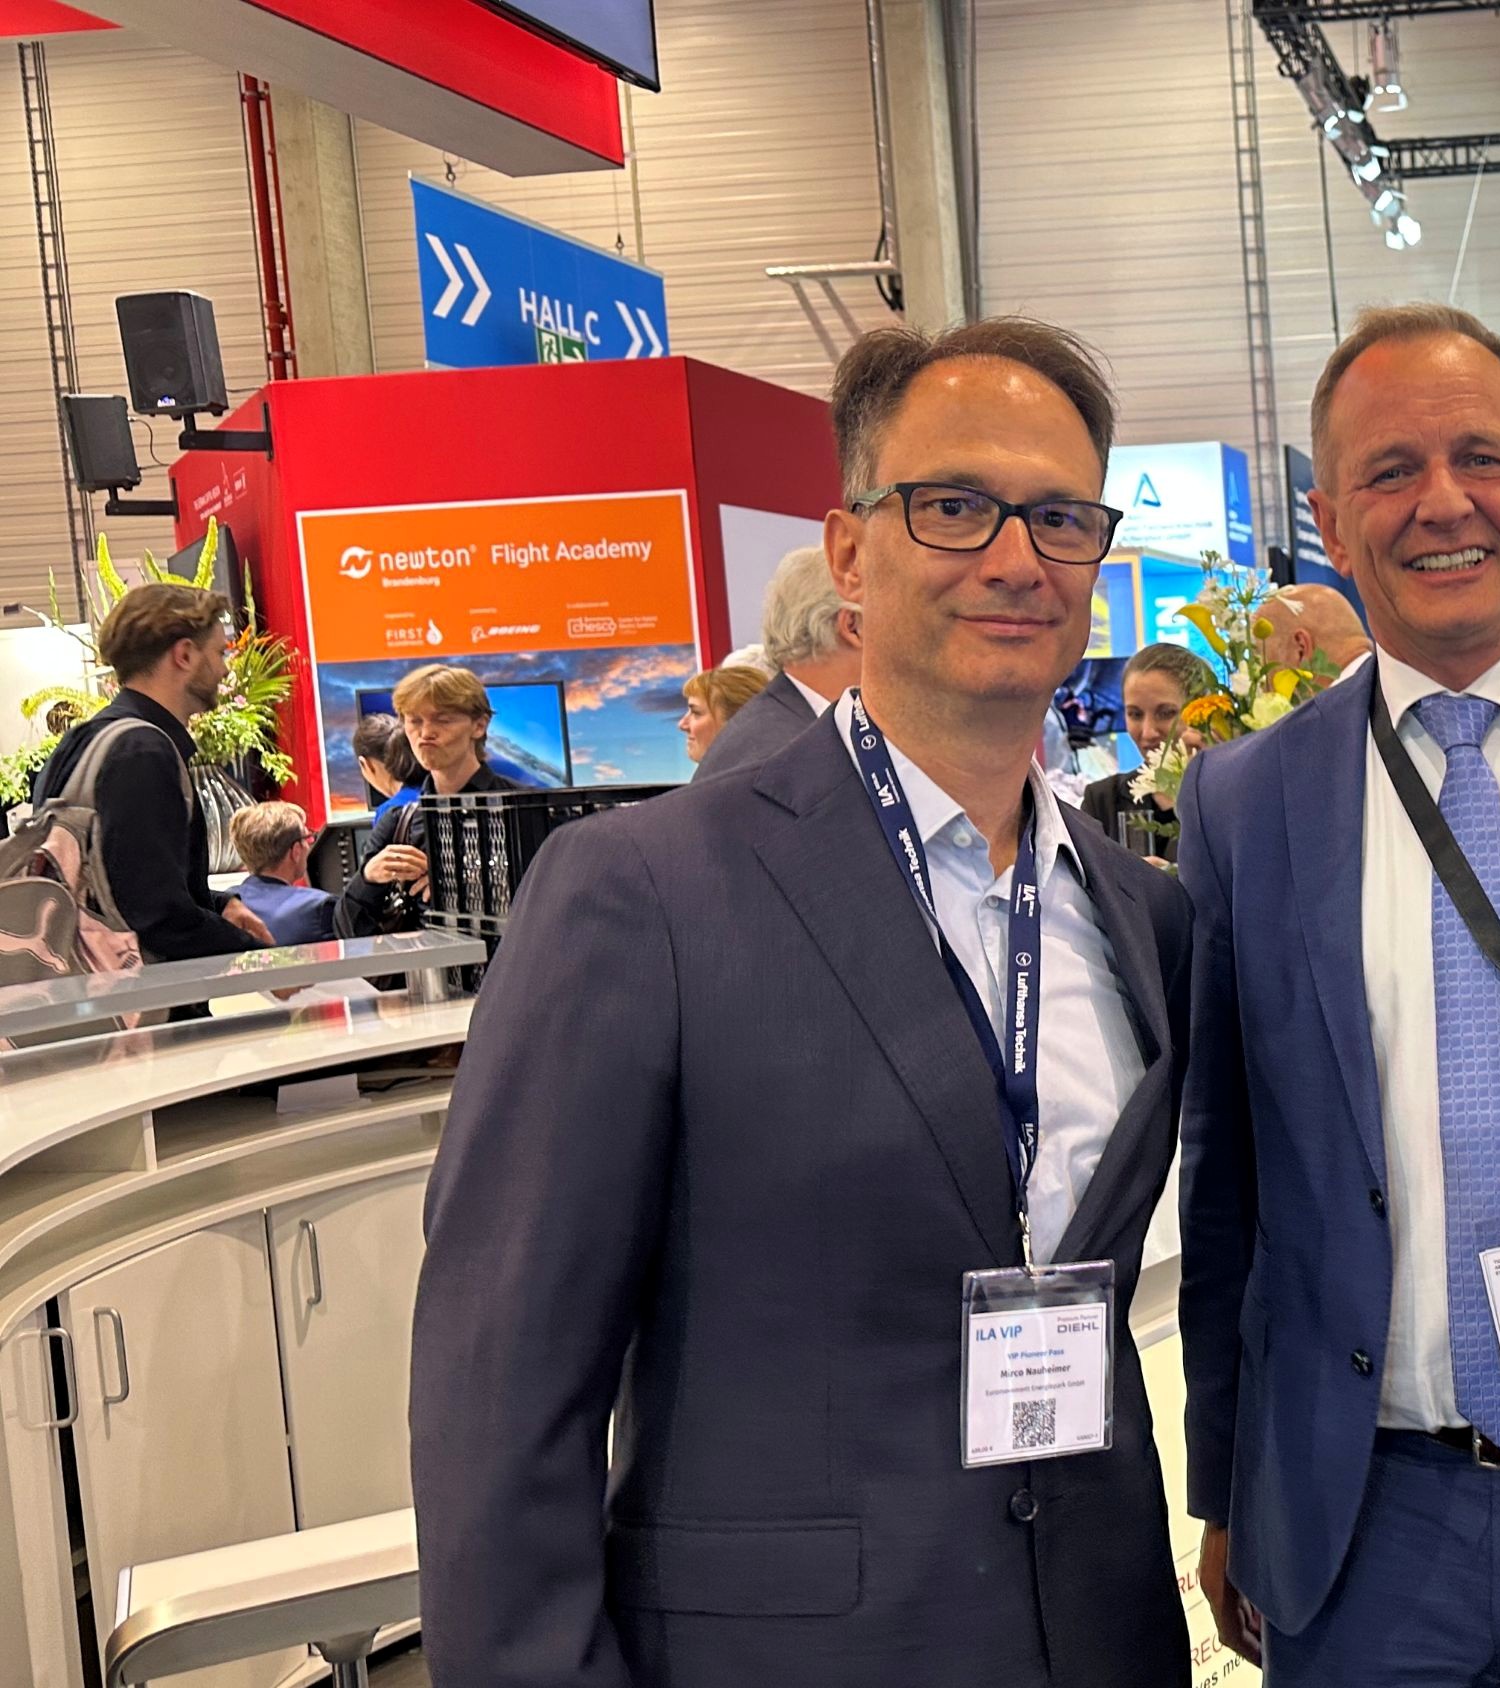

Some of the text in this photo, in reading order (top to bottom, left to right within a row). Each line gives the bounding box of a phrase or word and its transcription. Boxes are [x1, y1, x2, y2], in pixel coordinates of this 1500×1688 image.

[519, 287, 600, 345] HALL C
[491, 543, 550, 568] Flight
[555, 538, 652, 562] Academy
[382, 575, 440, 588] Brandenburg
[385, 627, 424, 641] FIRST
[487, 624, 541, 636] BOEING
[898, 828, 920, 874] Technik
[1015, 971, 1029, 1075] Lufthansa Technik
[976, 1325, 1023, 1342] ILA VIP
[1057, 1322, 1099, 1333] DIEHL
[1007, 1352, 1019, 1360] VIP
